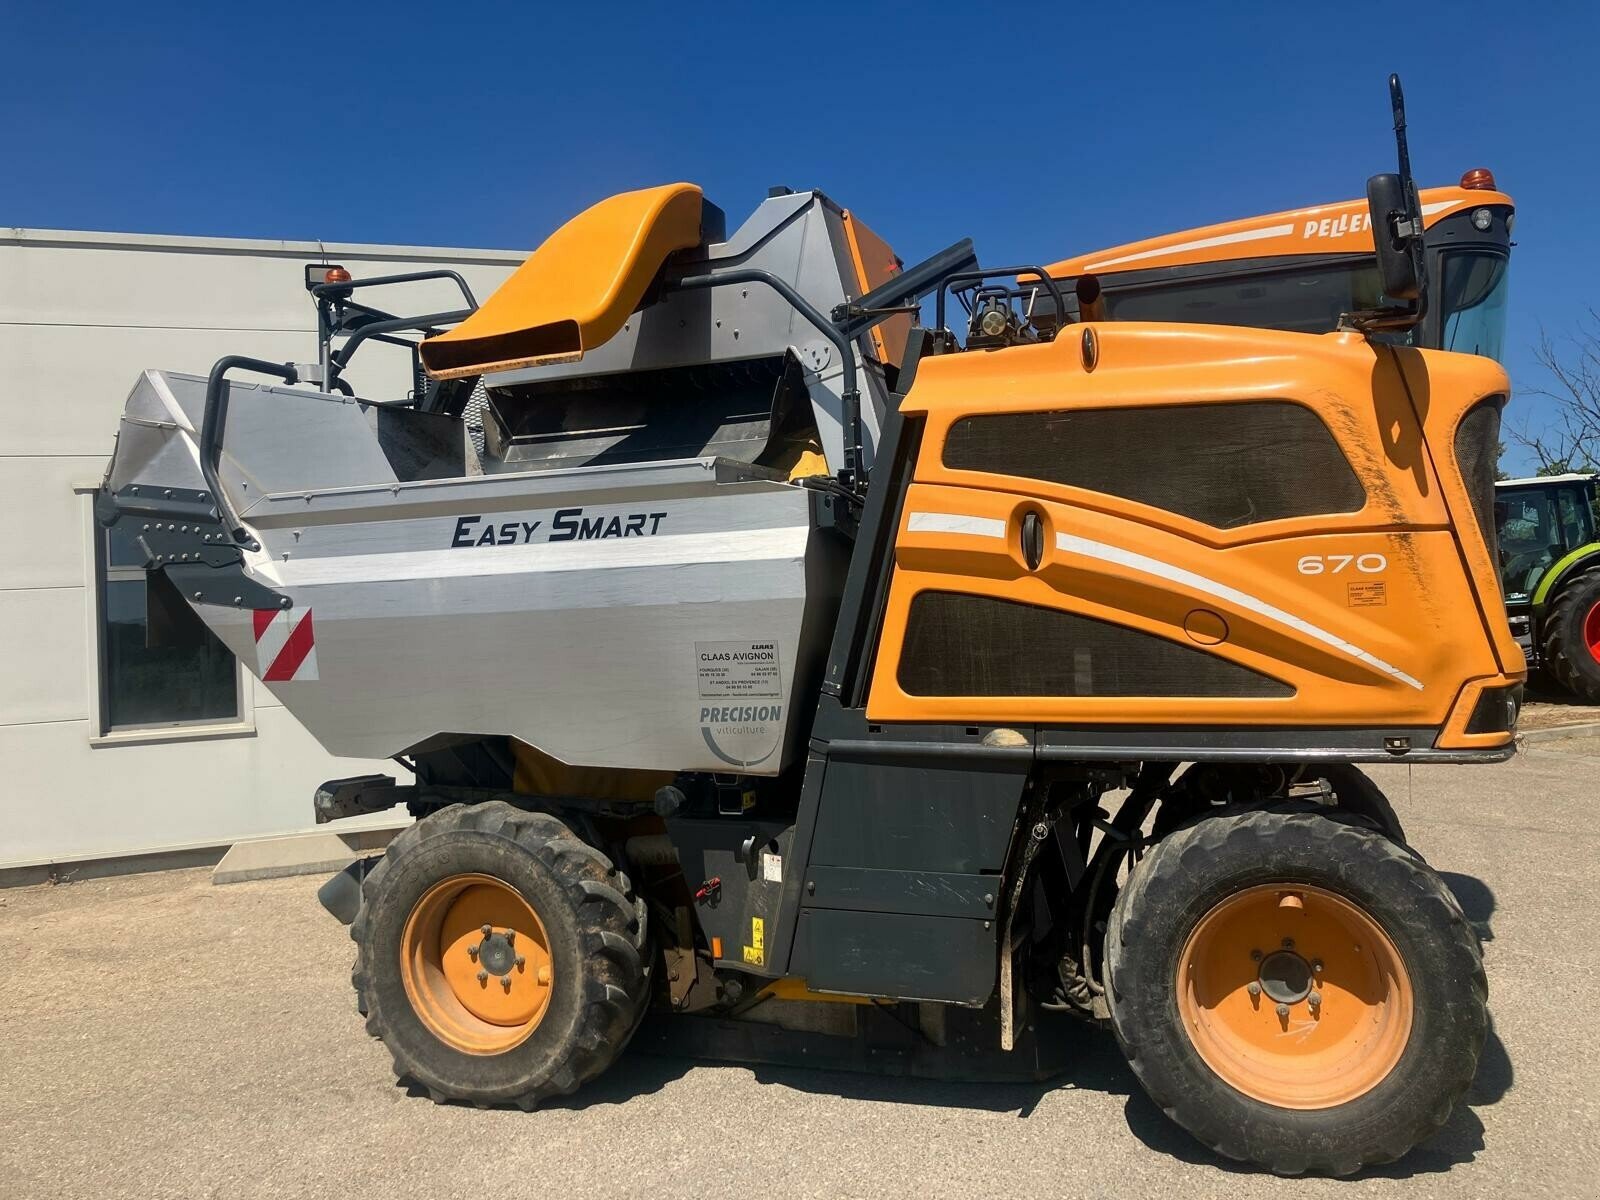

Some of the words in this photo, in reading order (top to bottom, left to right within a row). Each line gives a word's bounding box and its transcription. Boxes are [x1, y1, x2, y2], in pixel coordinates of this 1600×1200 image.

[1303, 213, 1372, 239] PELLEN
[451, 515, 542, 548] EASY
[548, 508, 668, 542] SMART
[1297, 553, 1387, 575] 670
[700, 653, 731, 661] CLAAS
[732, 651, 774, 661] AVIGNON
[700, 706, 782, 722] PRECISION
[716, 725, 765, 735] viticulture
